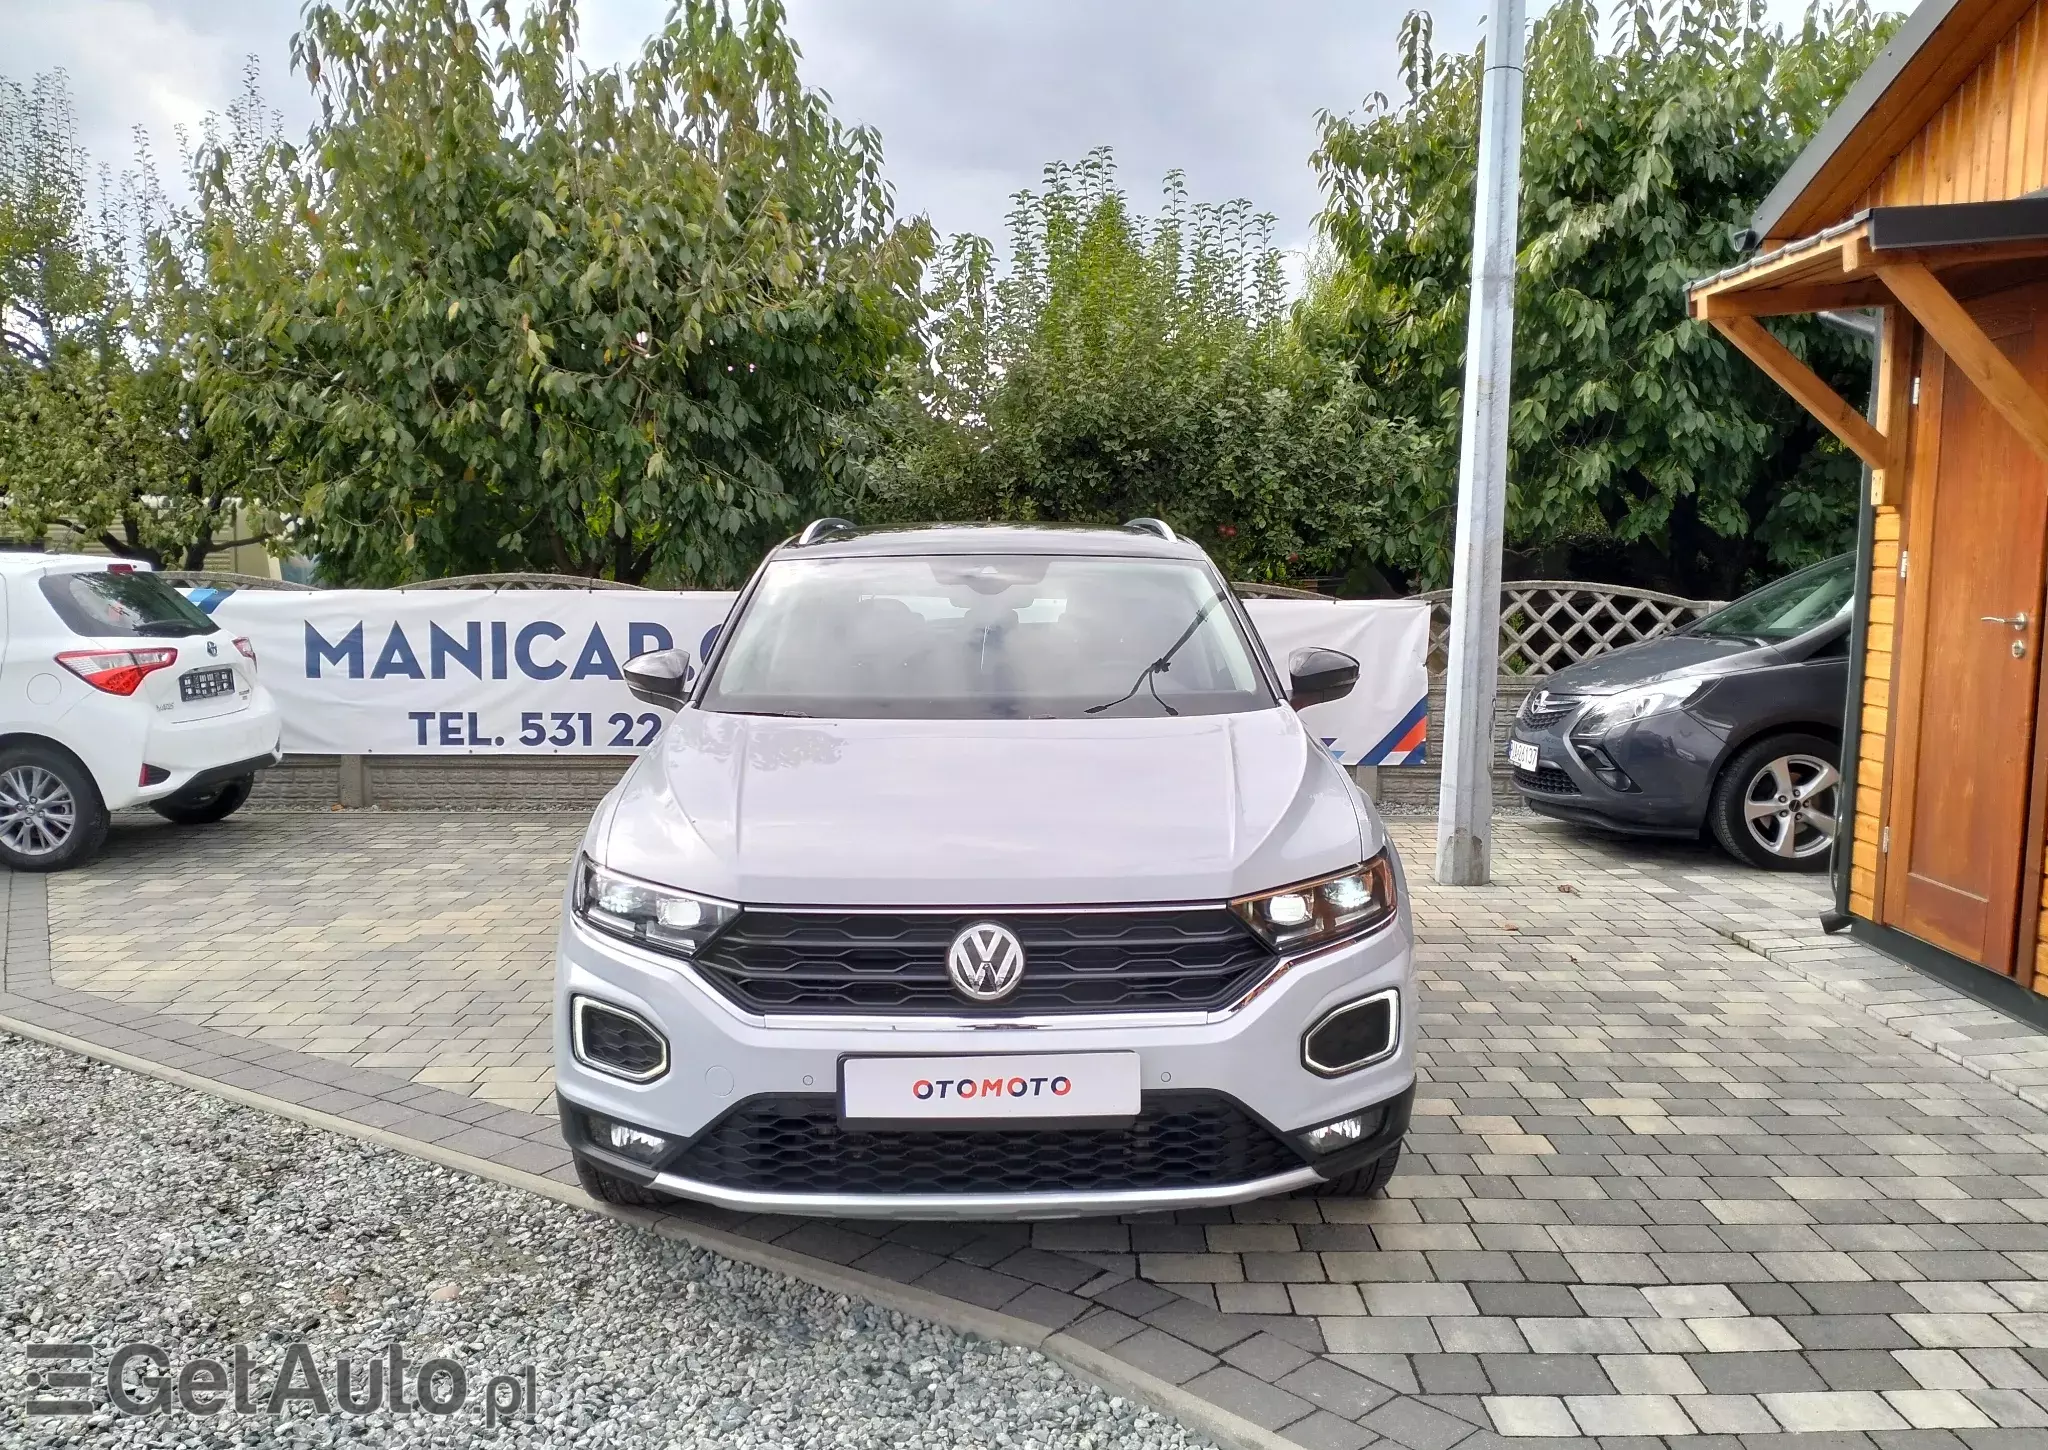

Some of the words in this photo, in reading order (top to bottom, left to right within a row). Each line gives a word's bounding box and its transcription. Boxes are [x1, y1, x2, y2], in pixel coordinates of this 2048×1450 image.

[408, 712, 505, 747] TEL.
[519, 712, 592, 747] 531
[912, 1076, 1071, 1100] OTOMOTO
